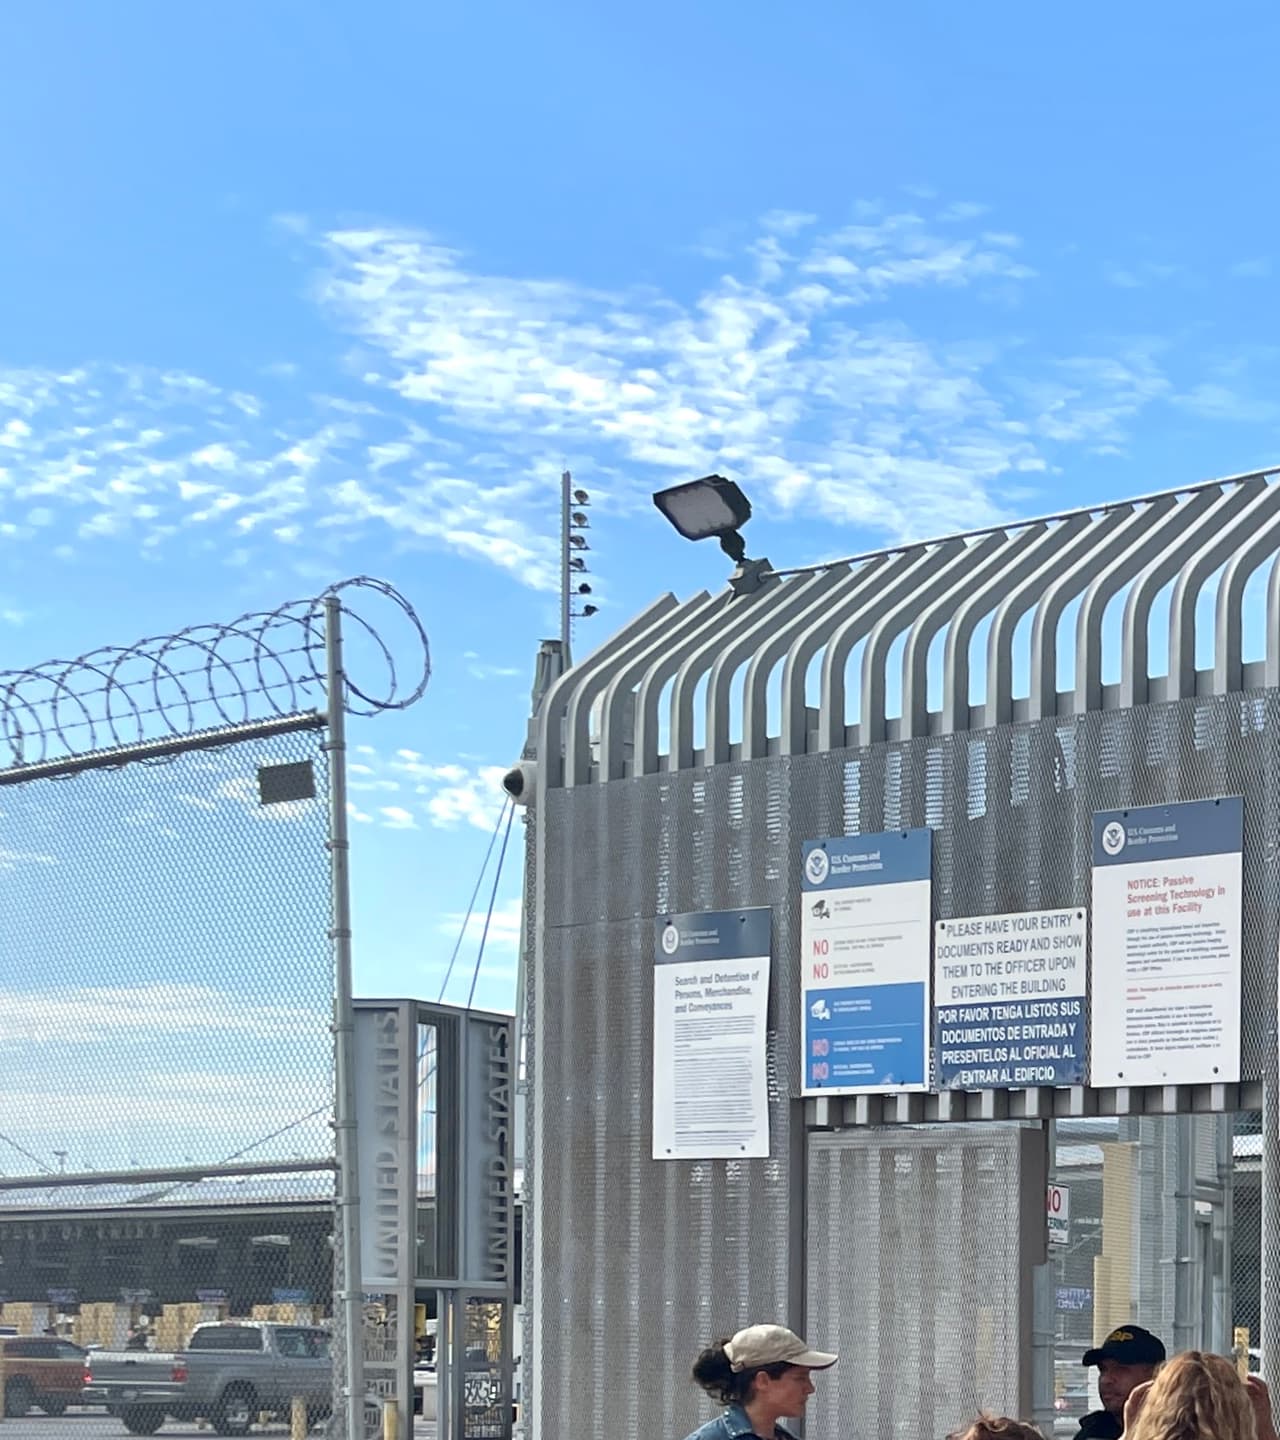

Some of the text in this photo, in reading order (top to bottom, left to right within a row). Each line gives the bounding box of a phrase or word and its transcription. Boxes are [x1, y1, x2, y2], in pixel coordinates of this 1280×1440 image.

[1127, 875, 1194, 889] NOTICE: Passive
[1127, 885, 1225, 903] Screening Technology in
[1127, 903, 1202, 917] use at this Facility
[947, 914, 1072, 936] PLEASE HAVE YOUR ENTRY
[813, 939, 828, 955] NO
[937, 935, 1081, 958] DOCUMENTS READY AND SHOW
[813, 963, 828, 979] NO
[942, 956, 1075, 978] THEM TO THE OFFICER UPON
[951, 978, 1066, 999] ENTERING THE BUILDING
[938, 1001, 1080, 1023] POR FAVOR TENGA LISTOS SUS
[942, 1022, 1077, 1045] DOCUMENTOS DE ENTRADA Y
[942, 1044, 1076, 1064] PRESENTELOS AL OFICIAL AL
[960, 1065, 1054, 1084] ENTRAR AL EDIFICIO
[490, 1027, 508, 1280] UNITED STATES
